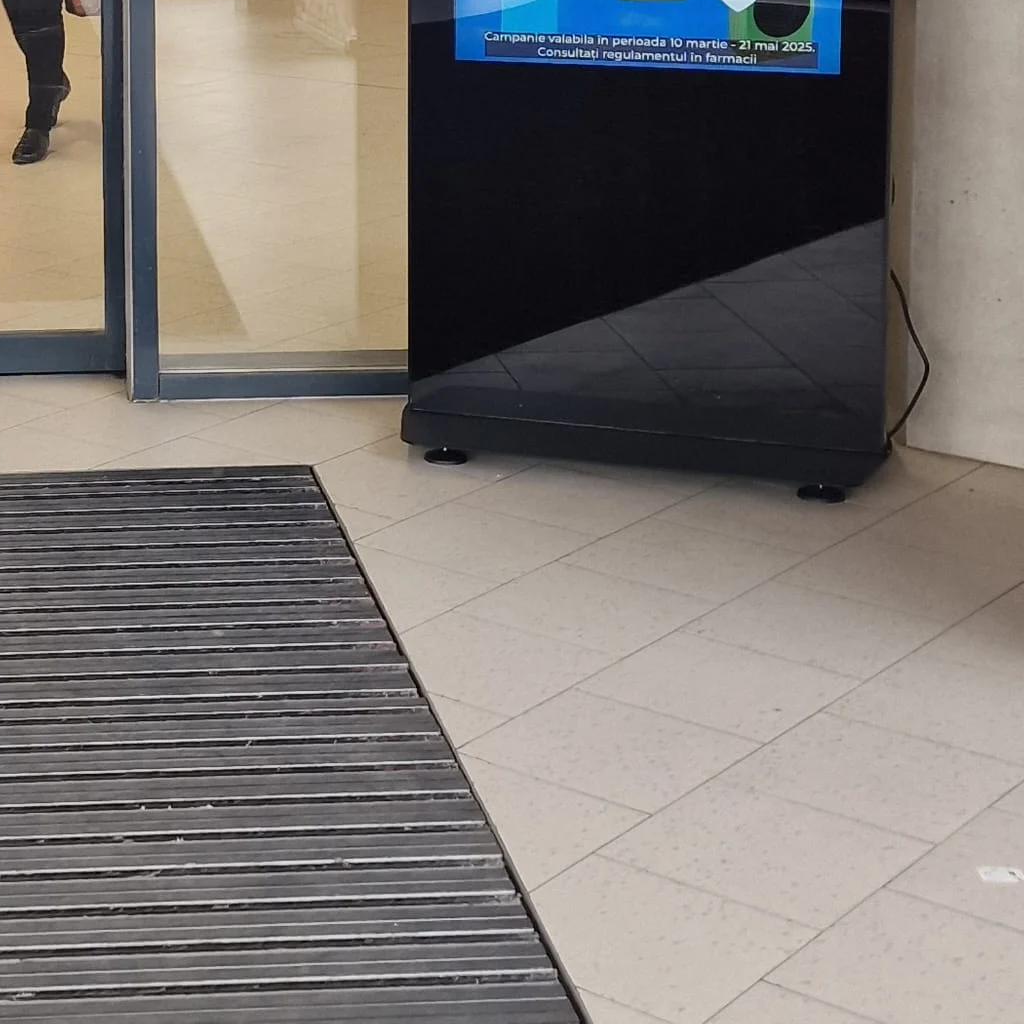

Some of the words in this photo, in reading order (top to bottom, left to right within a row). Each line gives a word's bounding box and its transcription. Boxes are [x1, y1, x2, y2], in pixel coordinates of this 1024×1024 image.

[483, 31, 546, 44] Campanie
[547, 34, 594, 45] valabila
[612, 36, 666, 48] perioada
[671, 38, 683, 47] 10
[686, 38, 728, 49] martie
[738, 40, 751, 51] 21
[754, 40, 779, 51] mai
[782, 41, 816, 53] 2025.
[602, 49, 687, 62] regulamentul
[705, 53, 757, 64] farmacii
